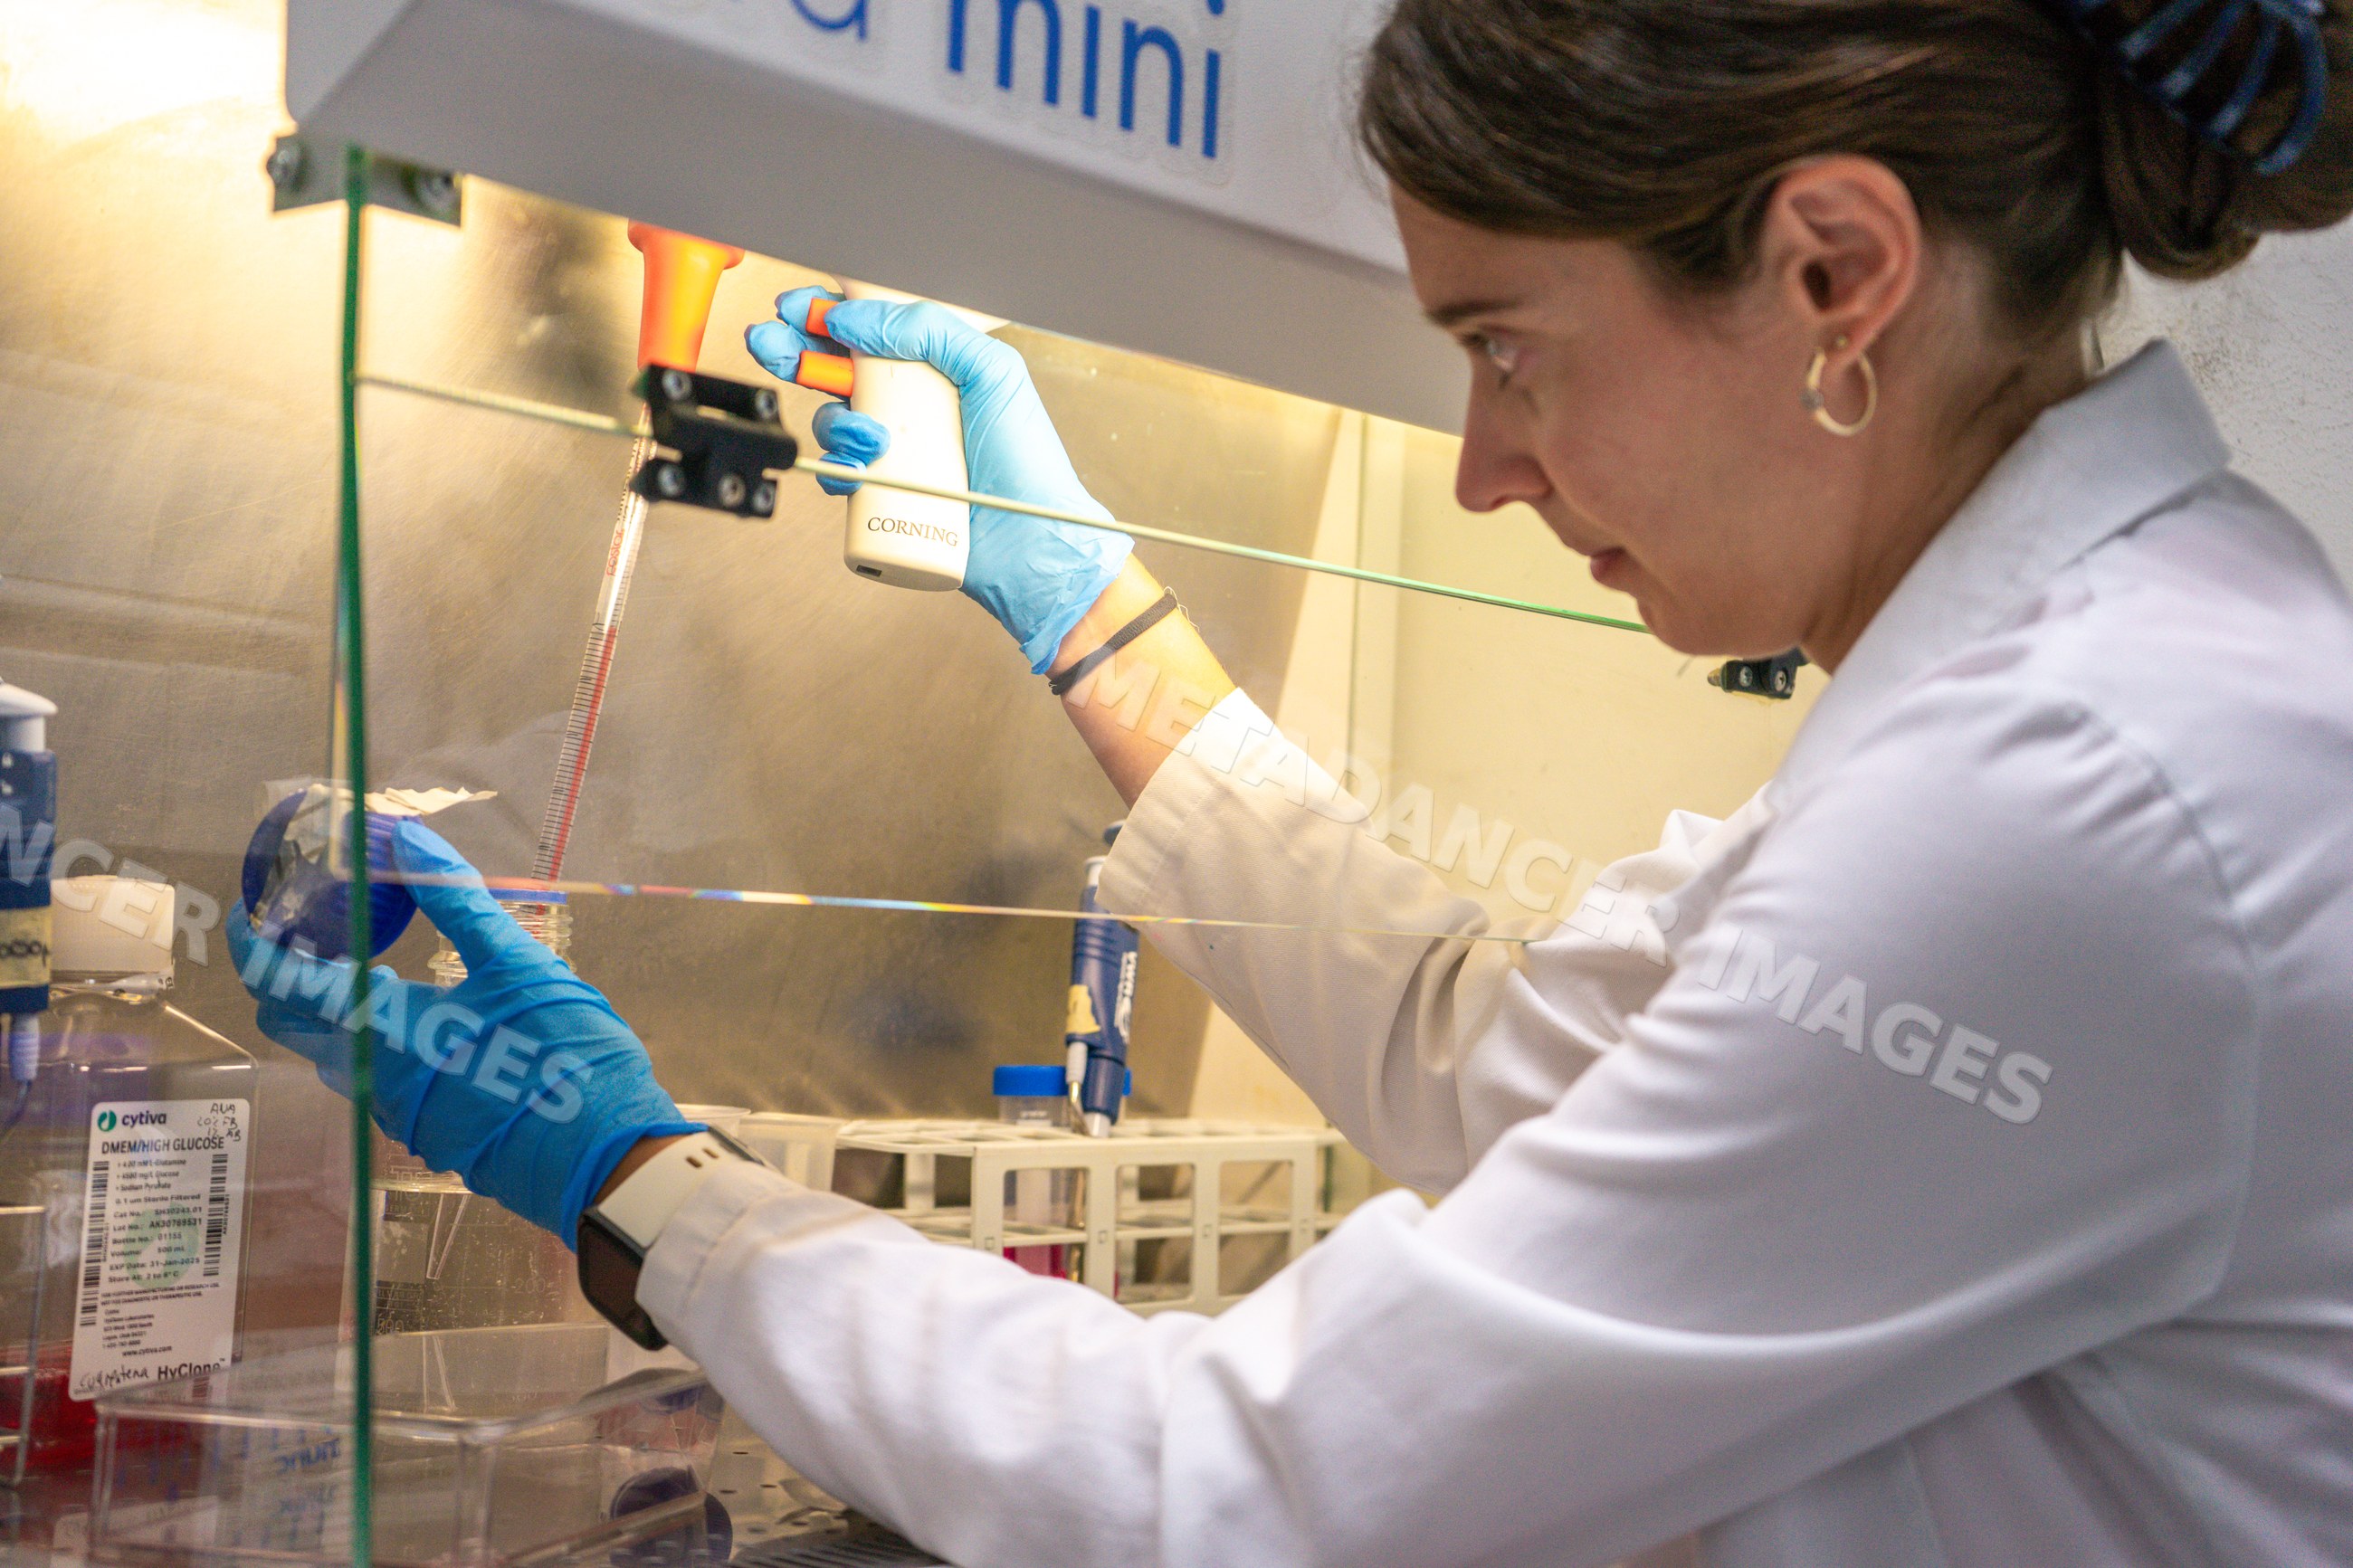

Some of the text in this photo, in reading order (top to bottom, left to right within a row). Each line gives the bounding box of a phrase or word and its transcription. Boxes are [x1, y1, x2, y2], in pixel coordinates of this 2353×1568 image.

[868, 517, 958, 546] CORNING
[121, 1110, 167, 1128] cytiva
[101, 1136, 224, 1155] DMEM/HIGH GLUCOSE
